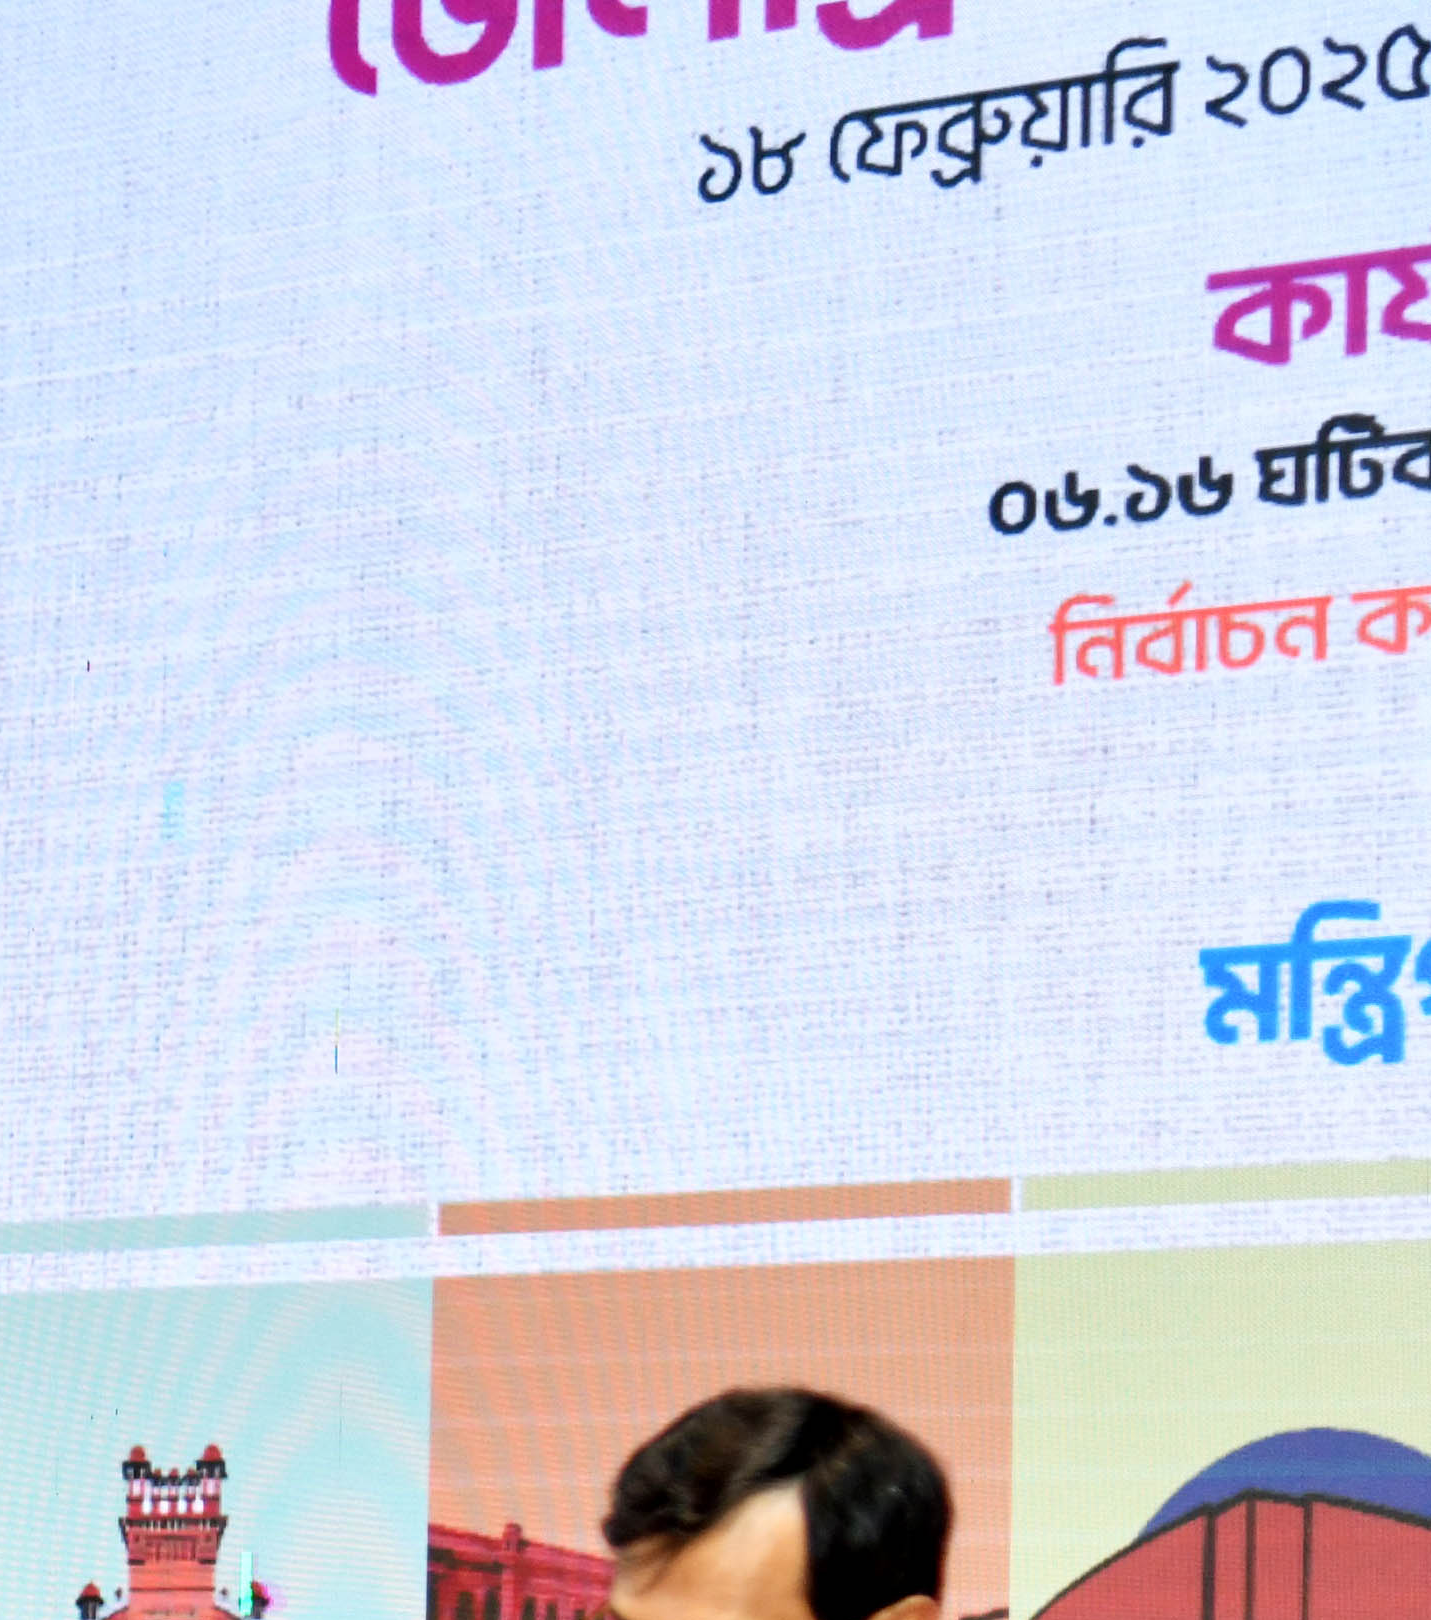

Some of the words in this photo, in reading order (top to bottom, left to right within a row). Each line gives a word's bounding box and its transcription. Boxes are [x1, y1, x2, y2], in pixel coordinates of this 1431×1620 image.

[698, 126, 806, 203] ১৮
[829, 37, 1180, 188] ফেব্রুয়ারি
[989, 456, 1233, 535] ০৬.১৬
[1047, 581, 1335, 686] নির্বাচন
[1198, 899, 1431, 1067] মন্ত্রি
